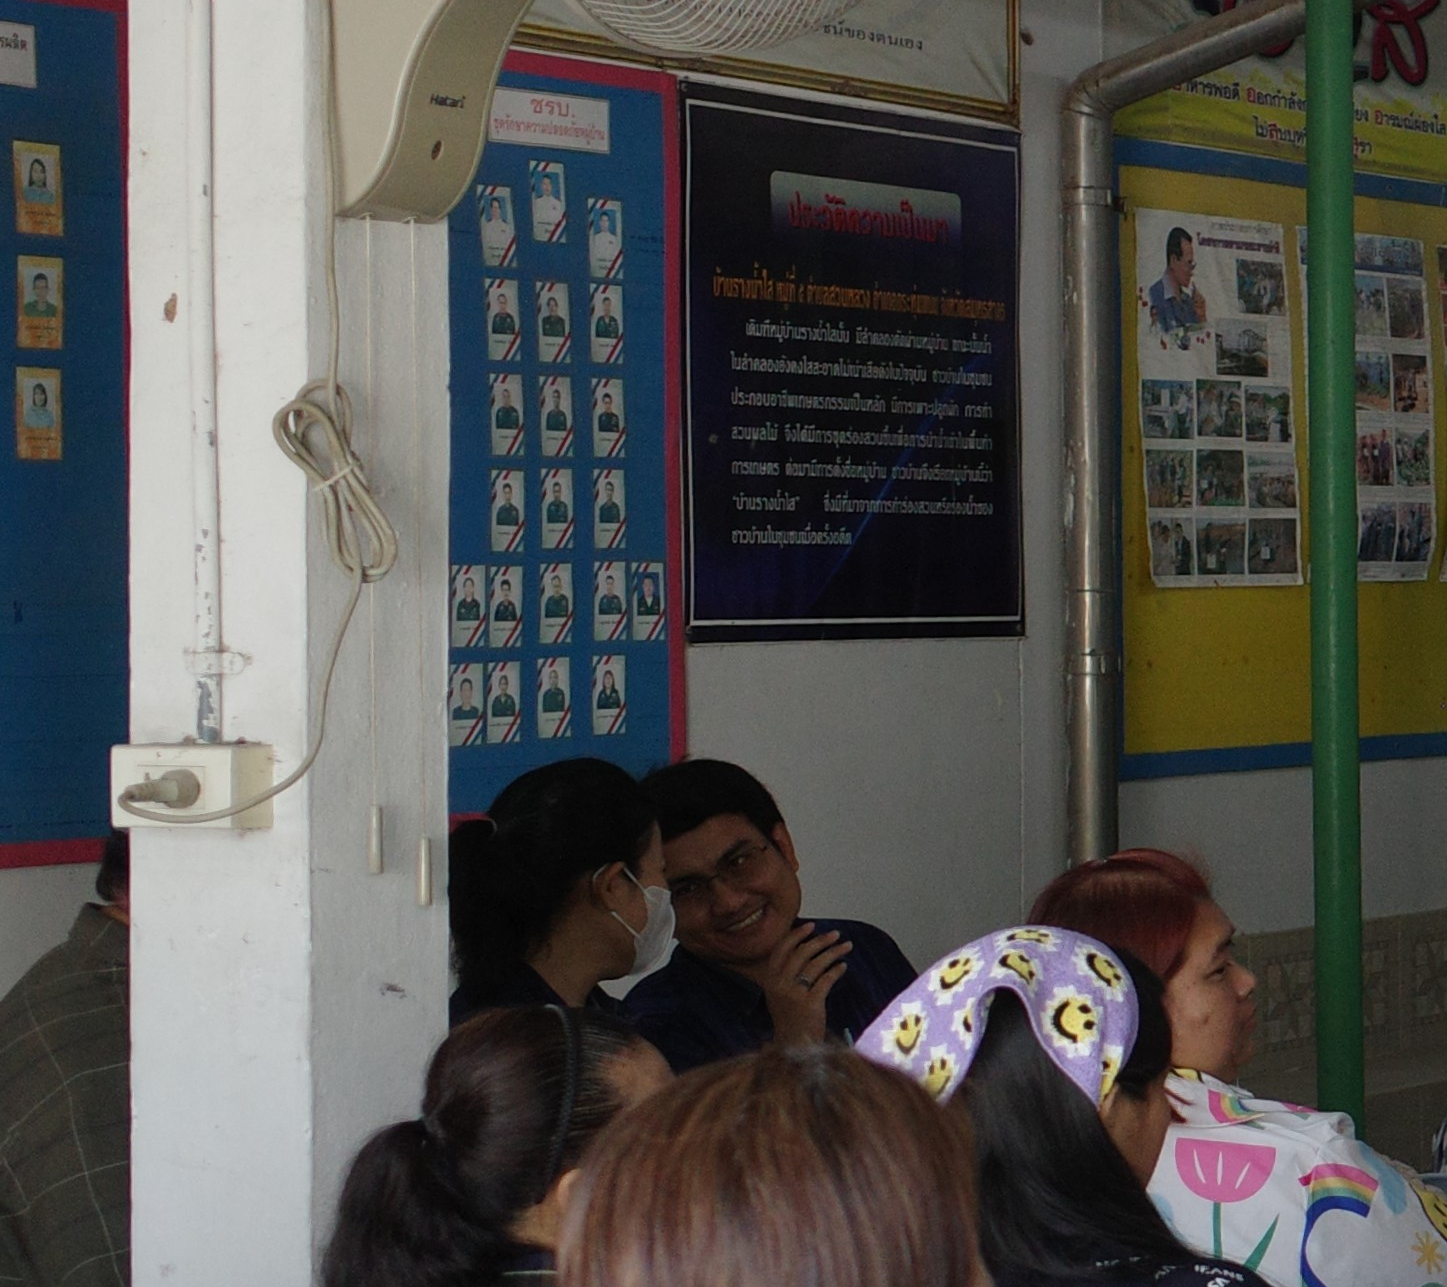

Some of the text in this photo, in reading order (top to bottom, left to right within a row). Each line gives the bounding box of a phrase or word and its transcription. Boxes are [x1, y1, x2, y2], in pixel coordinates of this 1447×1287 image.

[430, 92, 467, 110] Hatari
[529, 96, 576, 119] ชรบ.
[787, 190, 950, 245] ประวัติความเป็นมา
